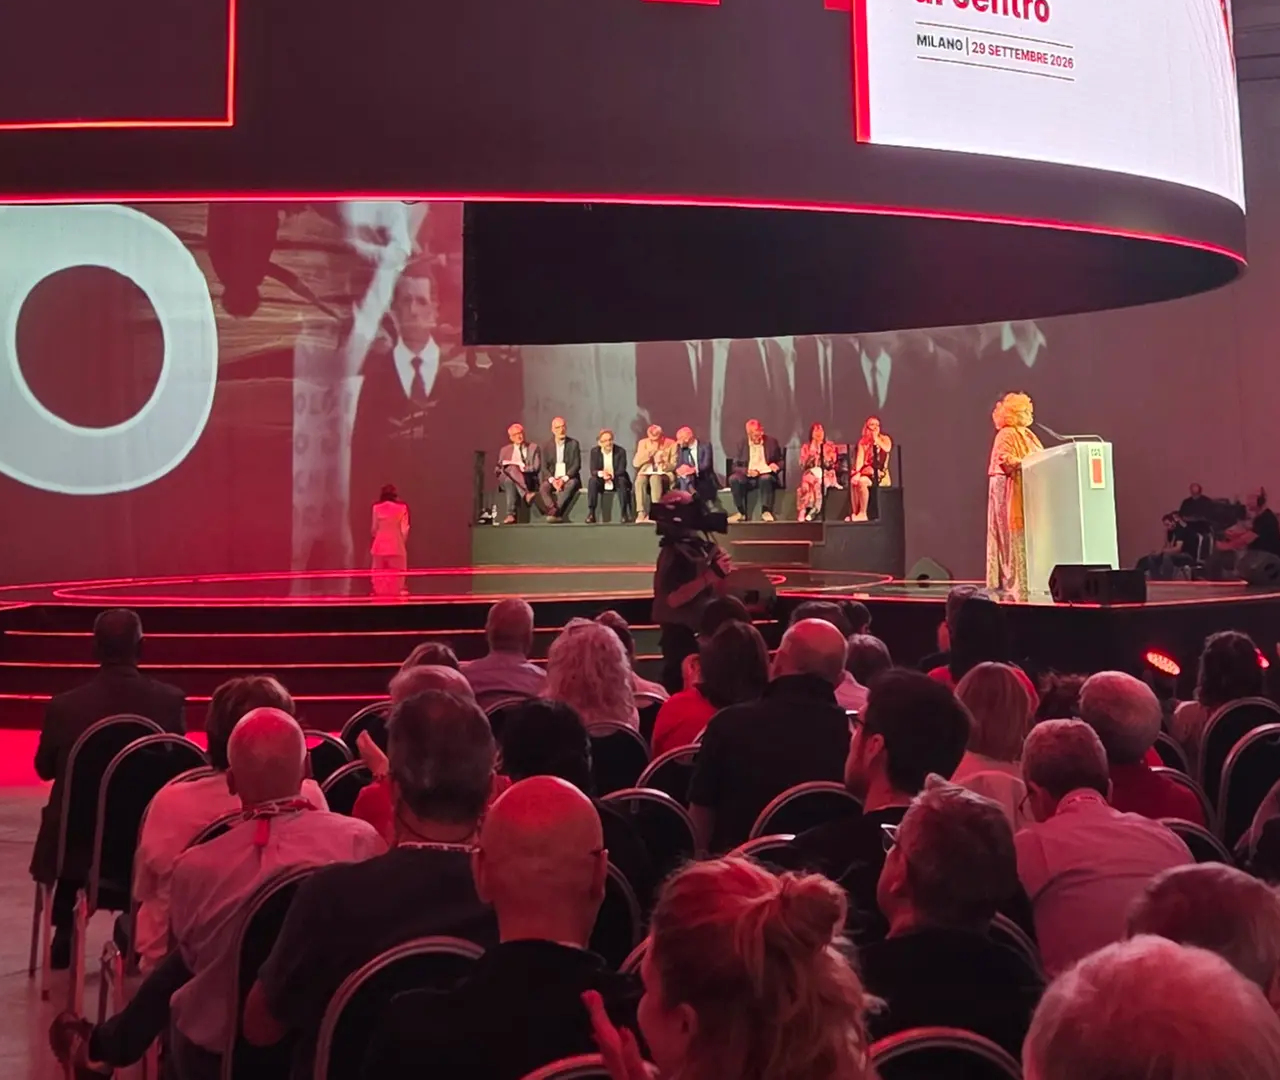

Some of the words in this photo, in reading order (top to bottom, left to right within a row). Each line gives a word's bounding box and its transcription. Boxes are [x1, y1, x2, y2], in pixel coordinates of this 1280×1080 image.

[916, 34, 963, 51] MILANO
[971, 42, 986, 54] 29
[988, 44, 1048, 64] SETTEMBRE
[1050, 54, 1074, 68] 2026
